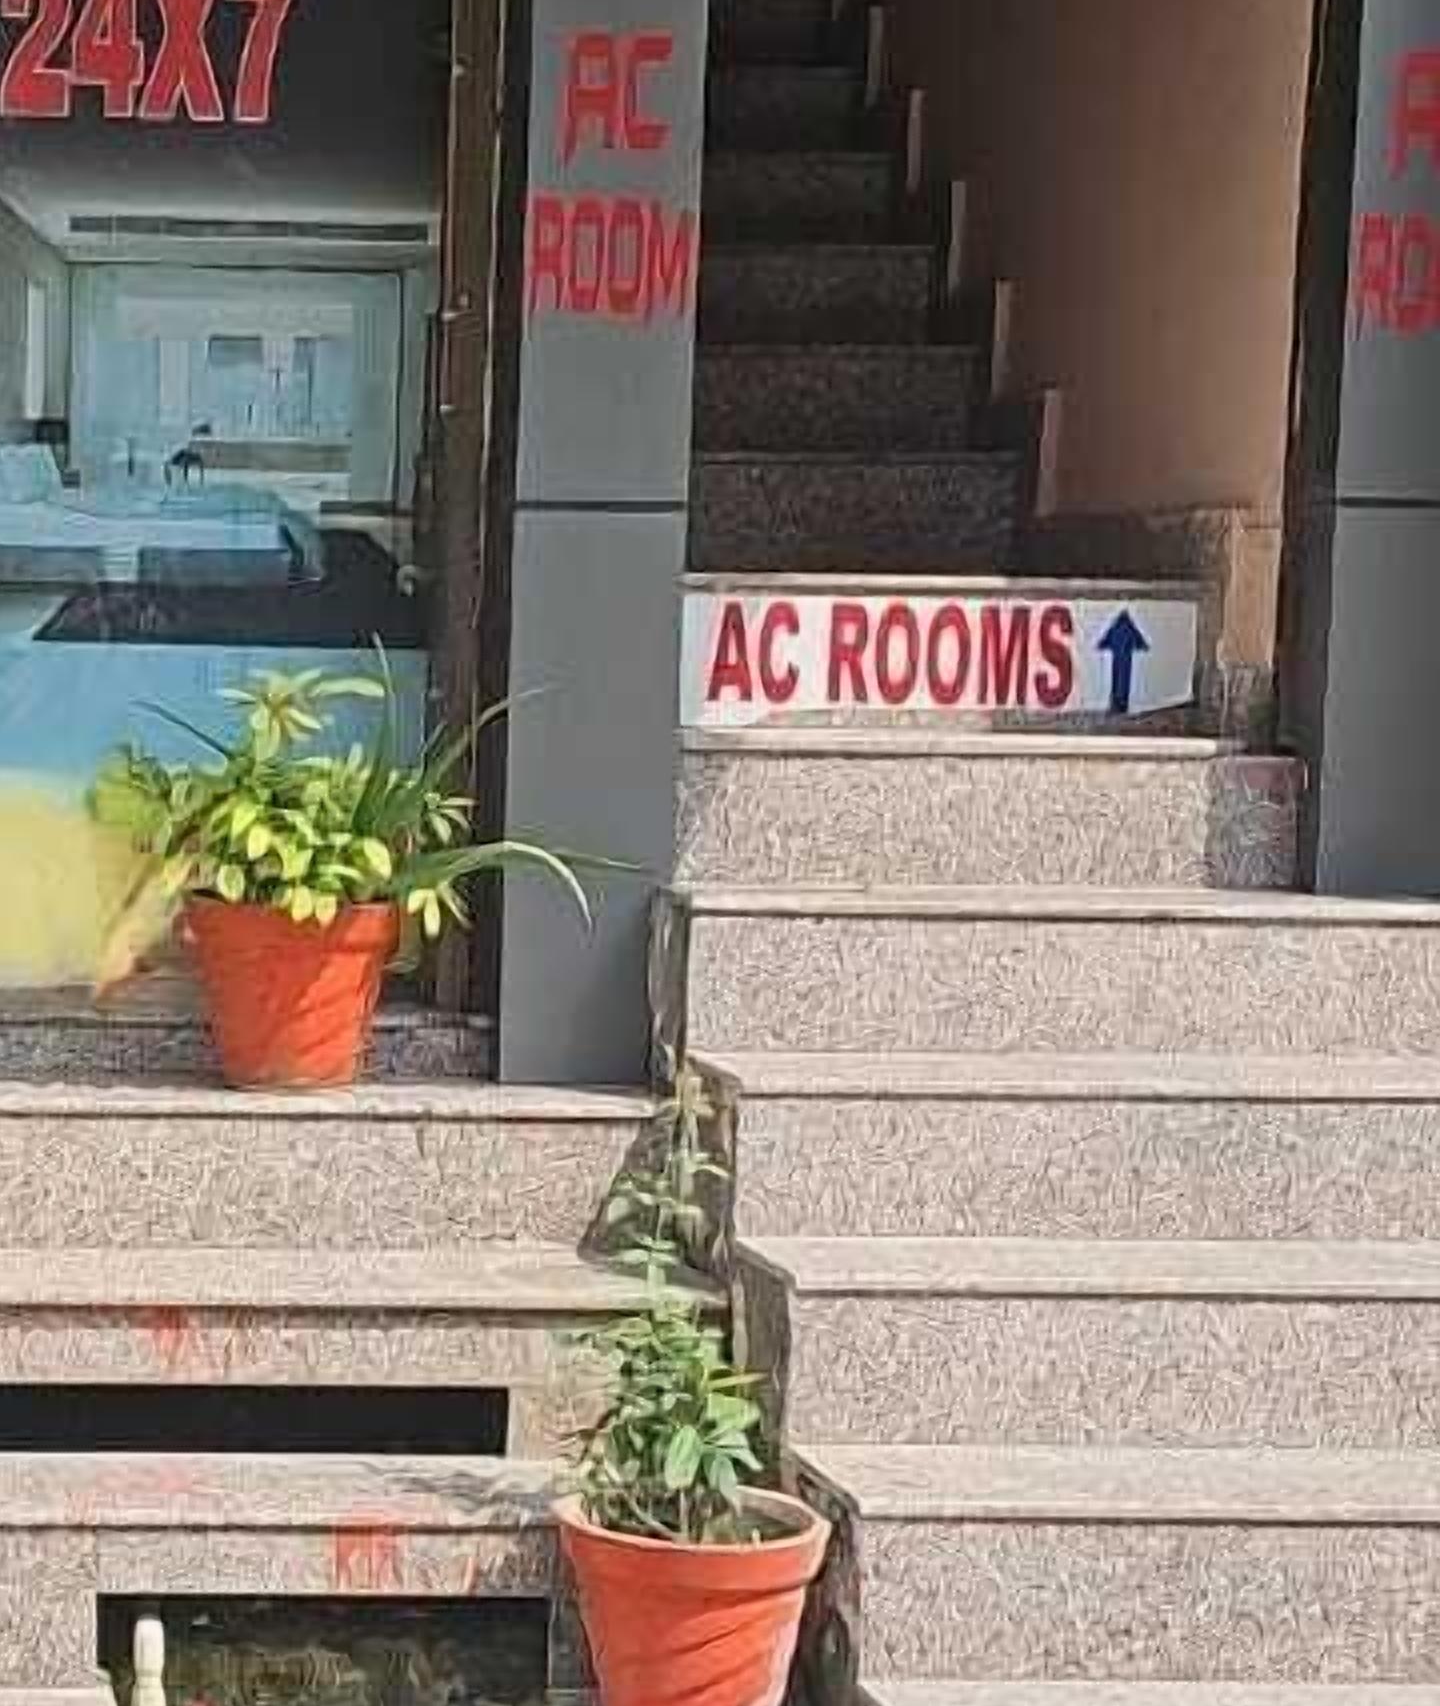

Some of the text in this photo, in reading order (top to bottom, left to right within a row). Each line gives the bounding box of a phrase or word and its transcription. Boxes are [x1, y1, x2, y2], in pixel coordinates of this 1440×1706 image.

[558, 32, 673, 163] AC
[527, 198, 697, 321] ROOM
[705, 600, 1075, 708] AC ROOMS
